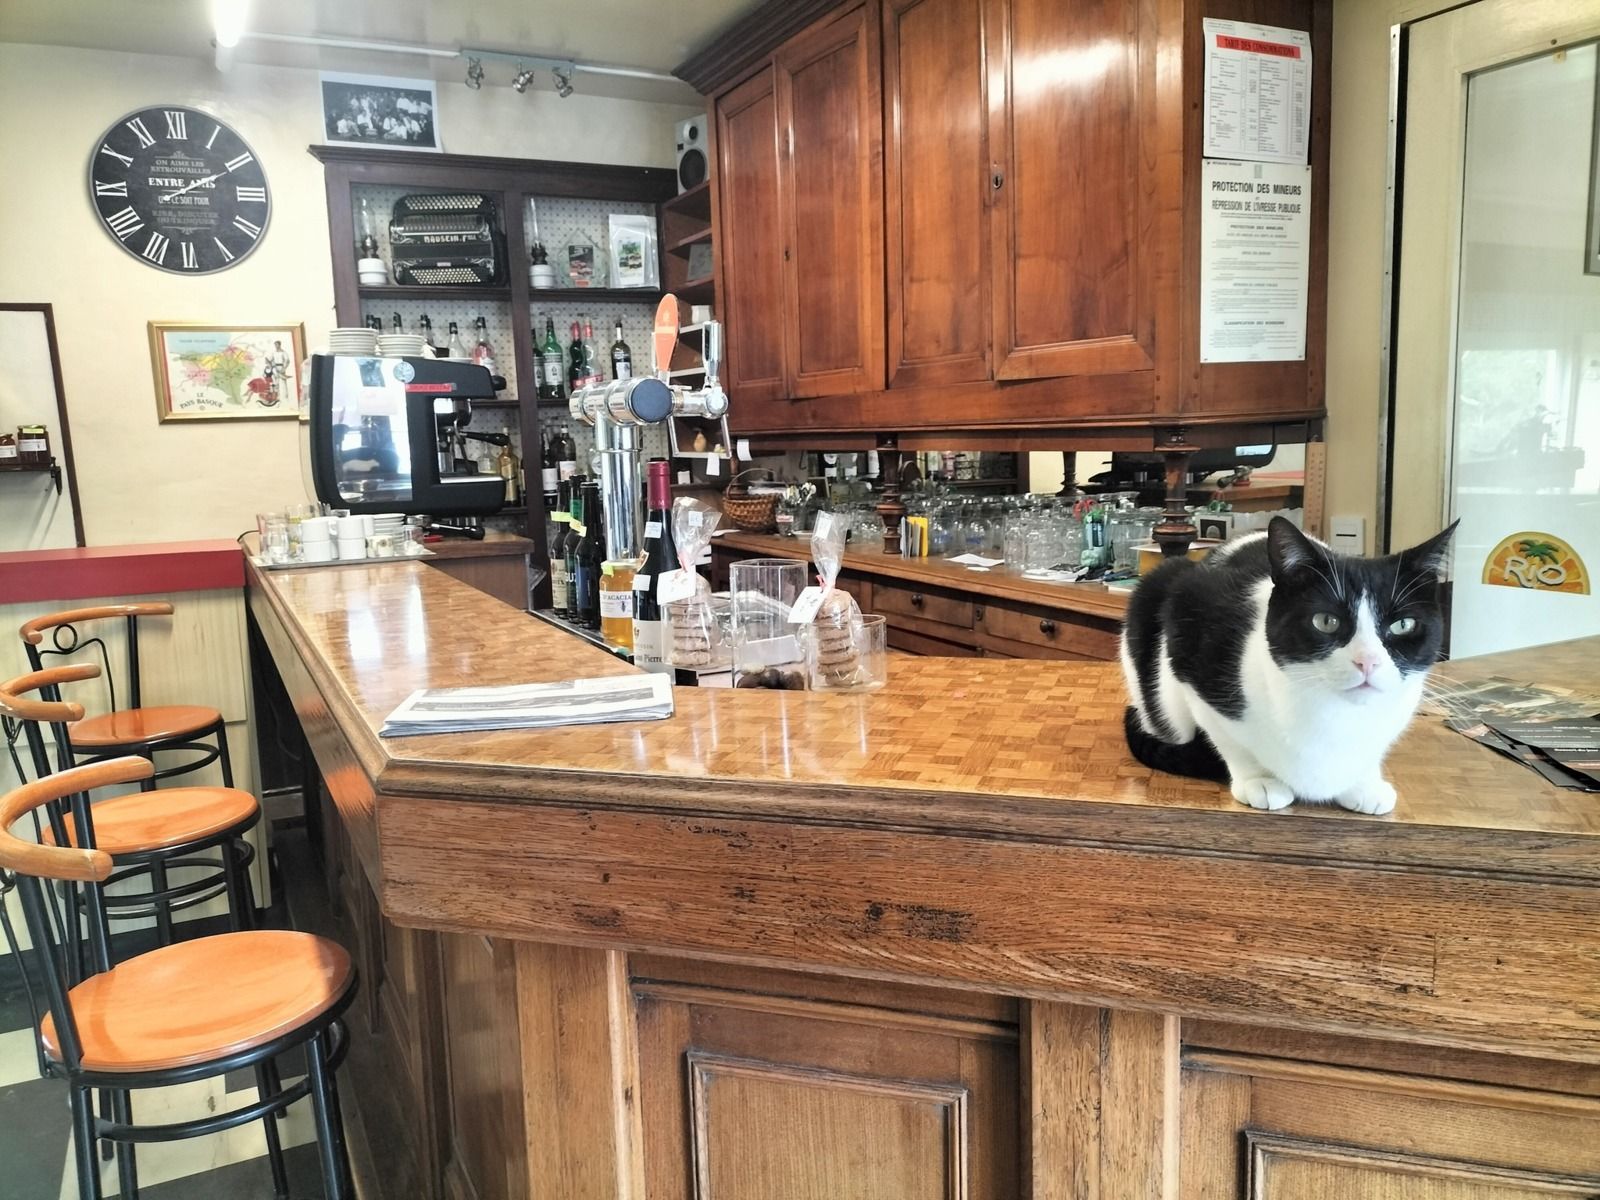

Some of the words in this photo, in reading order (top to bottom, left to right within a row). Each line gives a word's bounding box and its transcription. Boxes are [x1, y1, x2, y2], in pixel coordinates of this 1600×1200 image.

[126, 117, 156, 149] XI
[164, 111, 188, 140] XII
[206, 125, 222, 150] I
[101, 144, 134, 168] X
[224, 151, 254, 172] II
[148, 177, 185, 187] ENTRE
[150, 166, 212, 174] RETROUVAILLES
[95, 180, 128, 197] IX
[236, 186, 266, 203] III
[1212, 181, 1253, 192] PROTECTION
[1257, 183, 1270, 194] DES
[1273, 184, 1301, 195] MINEURS
[106, 205, 145, 241] VIII
[232, 215, 261, 240] IV
[142, 231, 170, 265] VII
[181, 242, 199, 268] VI
[214, 237, 235, 262] V
[179, 400, 196, 409] PAYS
[196, 398, 224, 408] BASQUE
